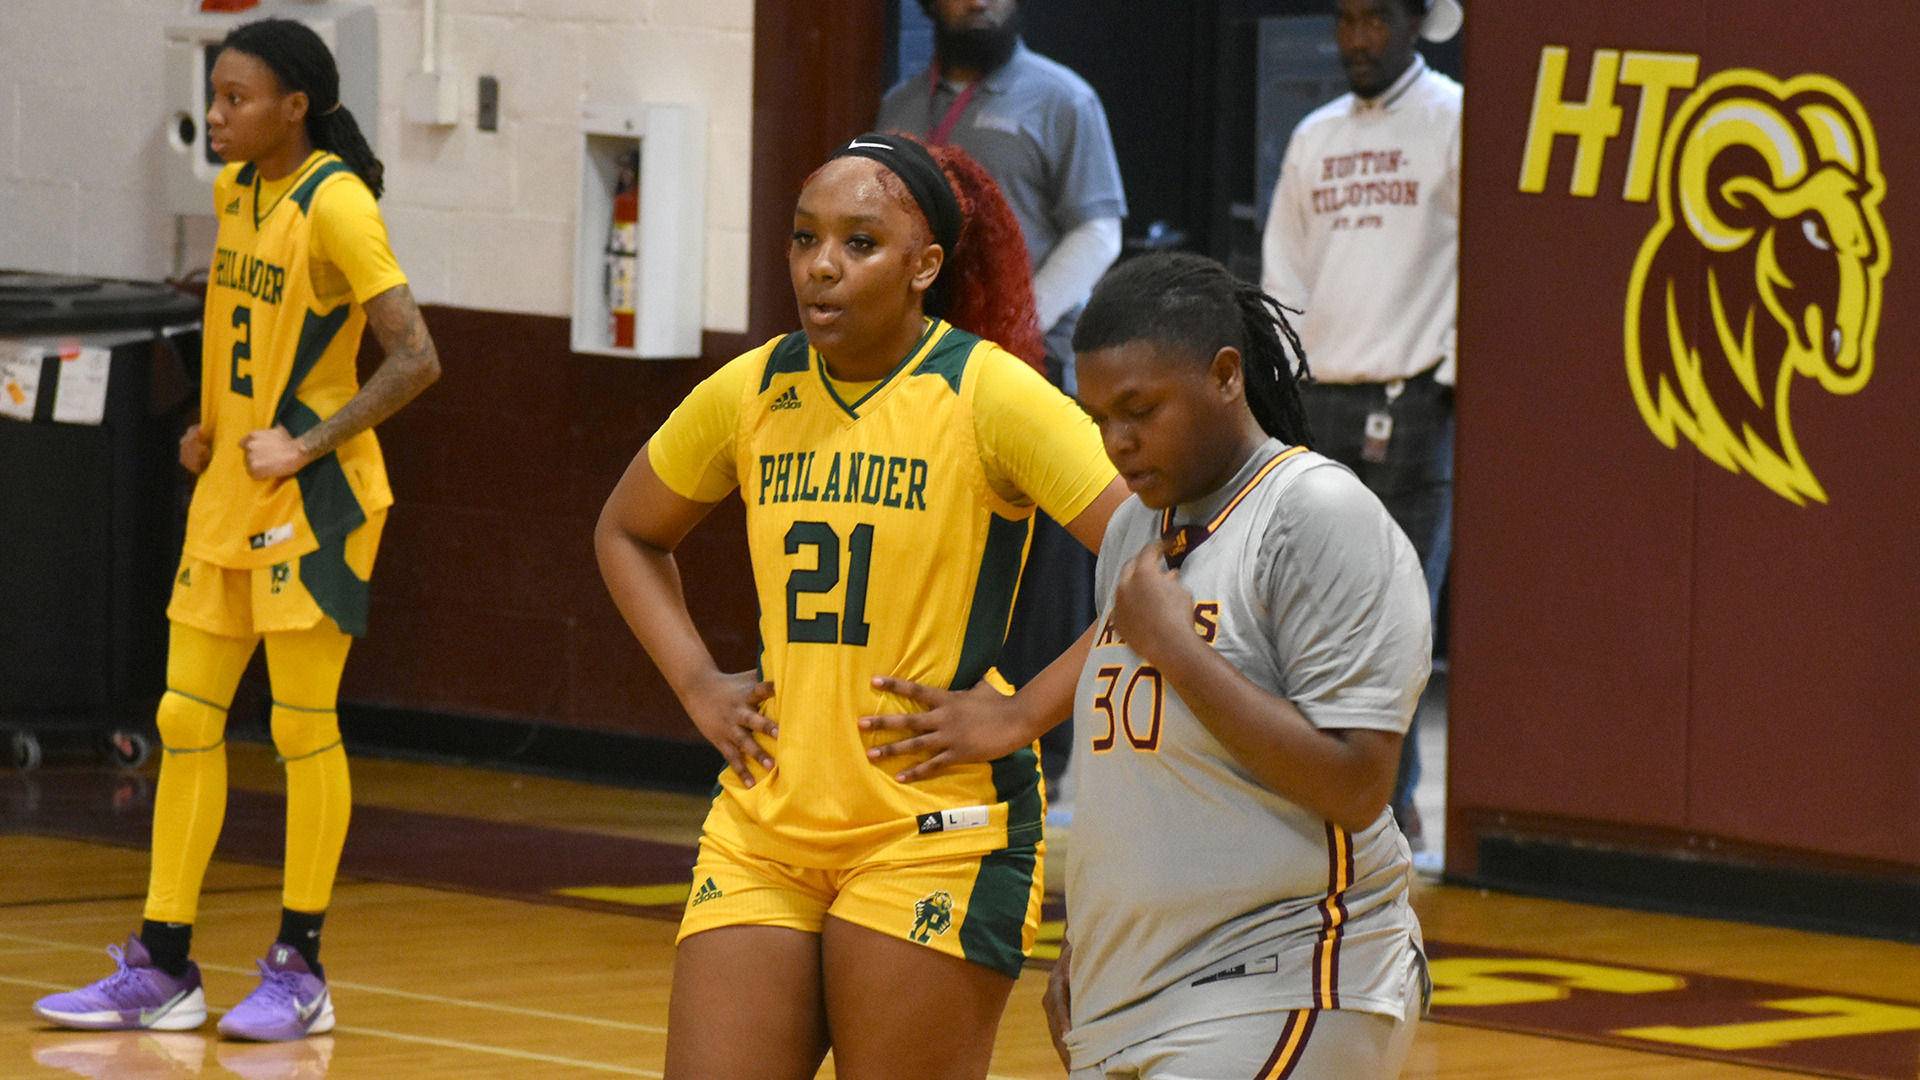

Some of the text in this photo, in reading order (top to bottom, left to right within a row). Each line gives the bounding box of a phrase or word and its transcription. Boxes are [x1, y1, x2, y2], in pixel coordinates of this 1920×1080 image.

[1518, 45, 1700, 203] HT
[230, 305, 254, 398] 2
[758, 450, 929, 512] PHILANDER
[783, 520, 875, 647] 21
[1094, 600, 1223, 650] RS
[1092, 663, 1165, 754] 30
[949, 813, 958, 825] L
[691, 889, 723, 908] adidas
